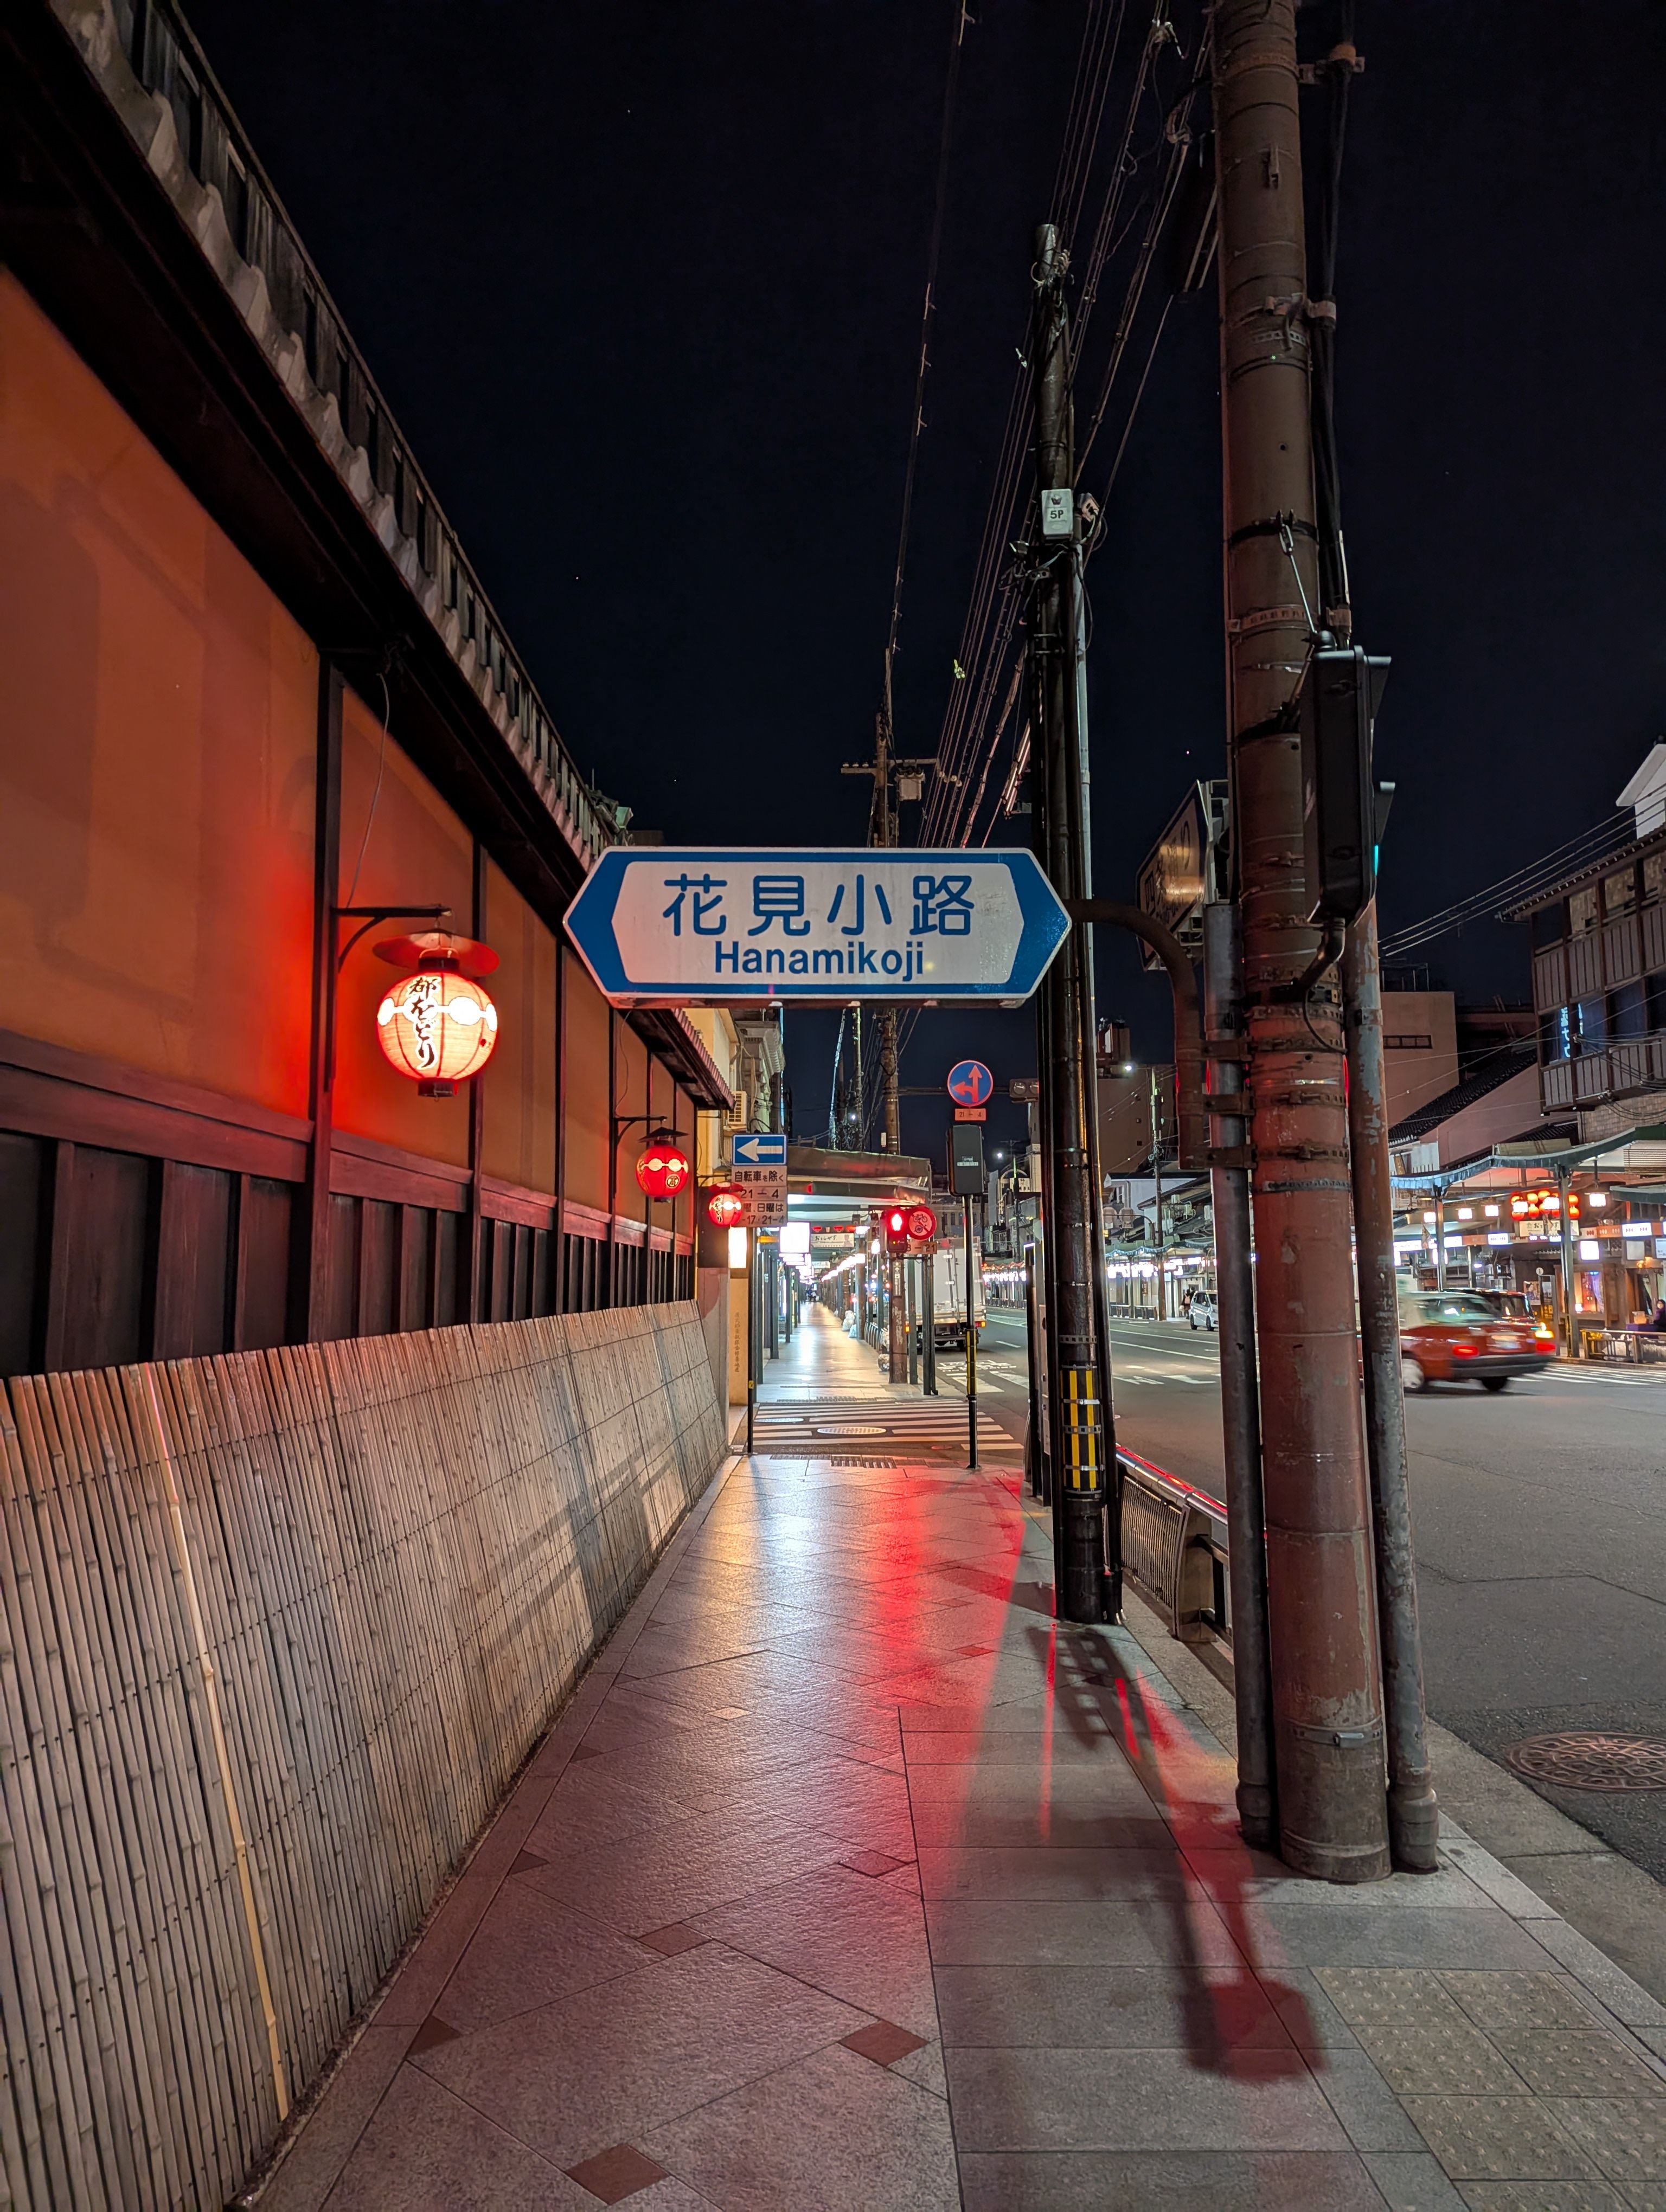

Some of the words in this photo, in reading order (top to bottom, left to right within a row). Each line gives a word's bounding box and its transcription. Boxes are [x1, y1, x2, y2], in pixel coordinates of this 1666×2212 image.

[1050, 510, 1064, 519] 5P
[663, 873, 975, 936] 花見小路
[715, 941, 924, 982] Hanamikoji
[734, 1170, 784, 1182] 自転車を除く
[743, 1203, 784, 1212] 曜、日曜は
